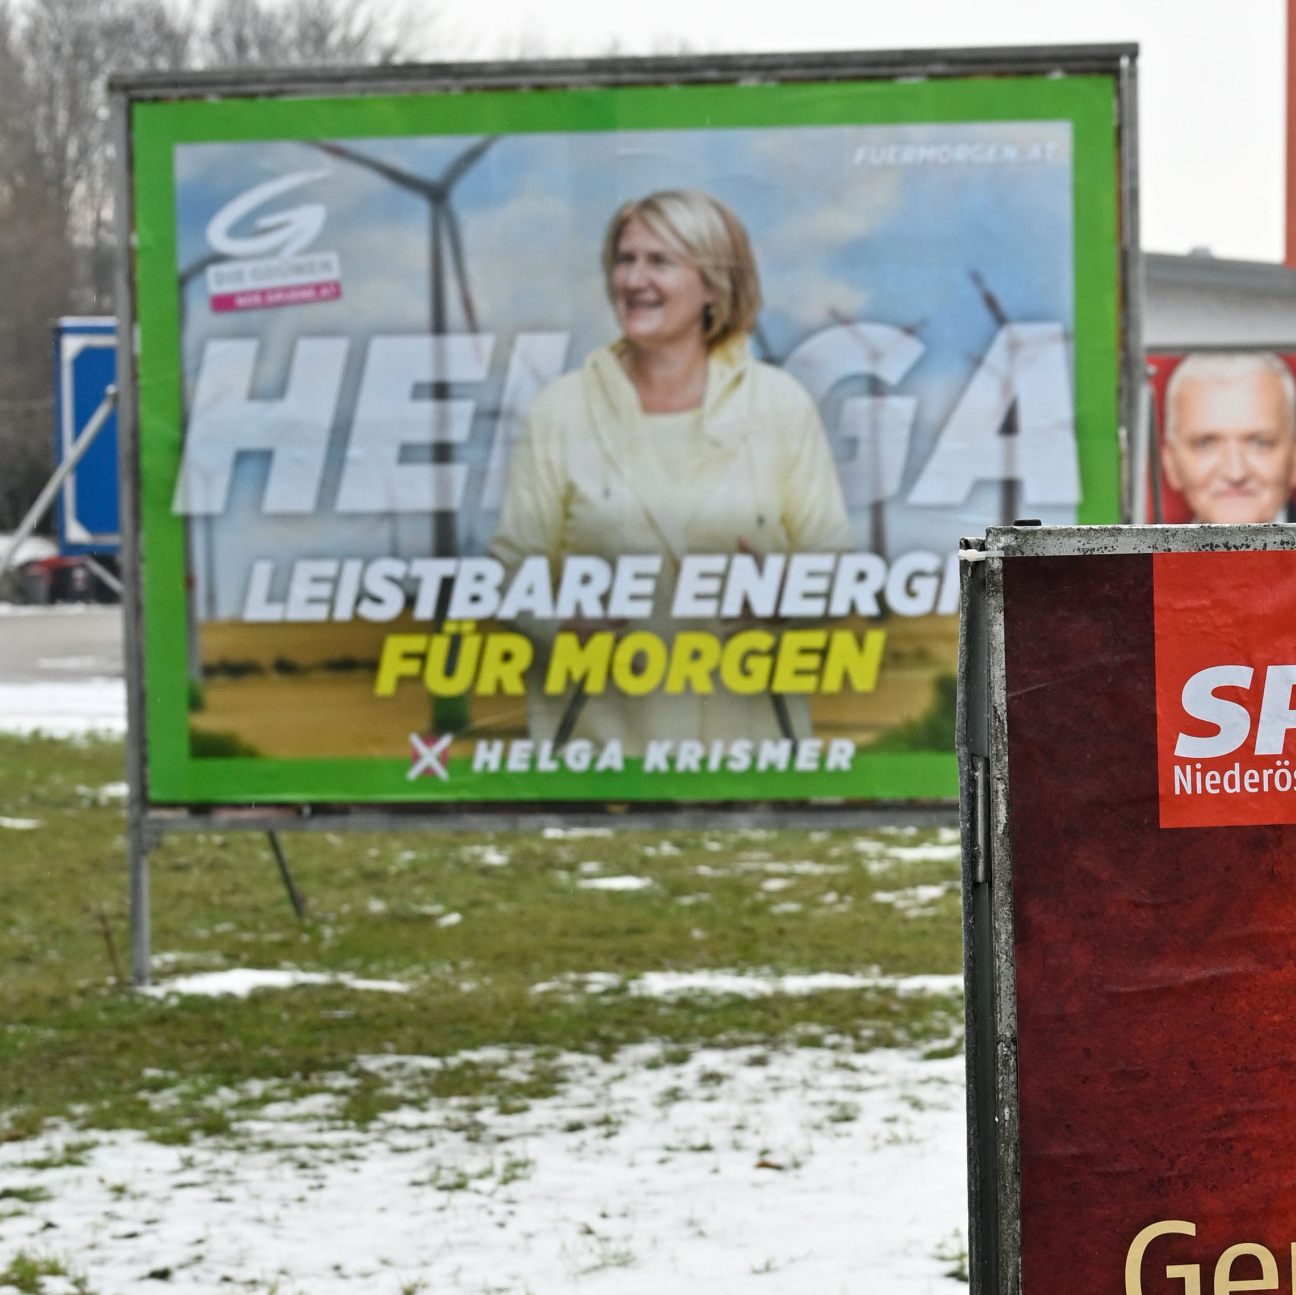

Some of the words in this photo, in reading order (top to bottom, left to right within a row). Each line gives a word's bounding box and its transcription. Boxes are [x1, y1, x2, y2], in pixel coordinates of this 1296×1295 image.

[243, 553, 662, 622] LEISTBARE
[671, 550, 960, 619] ENERGI
[373, 618, 534, 698] FÜR
[544, 628, 887, 697] MORGEN
[471, 737, 626, 774] HELGA
[643, 736, 857, 773] KRISMER
